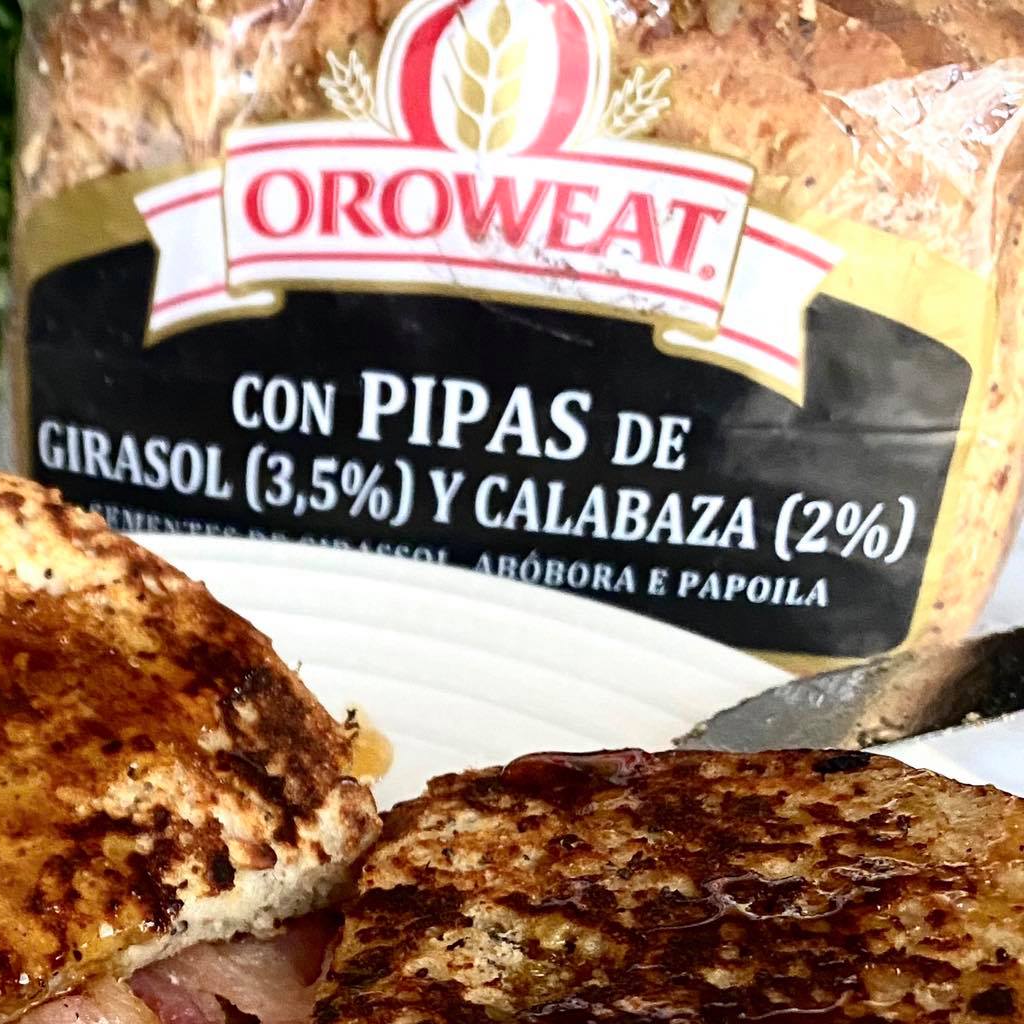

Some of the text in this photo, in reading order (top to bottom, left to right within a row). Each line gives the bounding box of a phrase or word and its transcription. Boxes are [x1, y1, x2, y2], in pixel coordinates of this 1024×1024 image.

[233, 370, 691, 471] CON PIPAS DE
[37, 420, 232, 500] GIRASOL
[246, 443, 414, 527] (3,5%)
[430, 469, 465, 524] Y
[475, 473, 758, 550] CALABAZA
[775, 492, 918, 563] (2%)
[646, 566, 670, 597] E
[678, 570, 830, 608] PAPOILA
